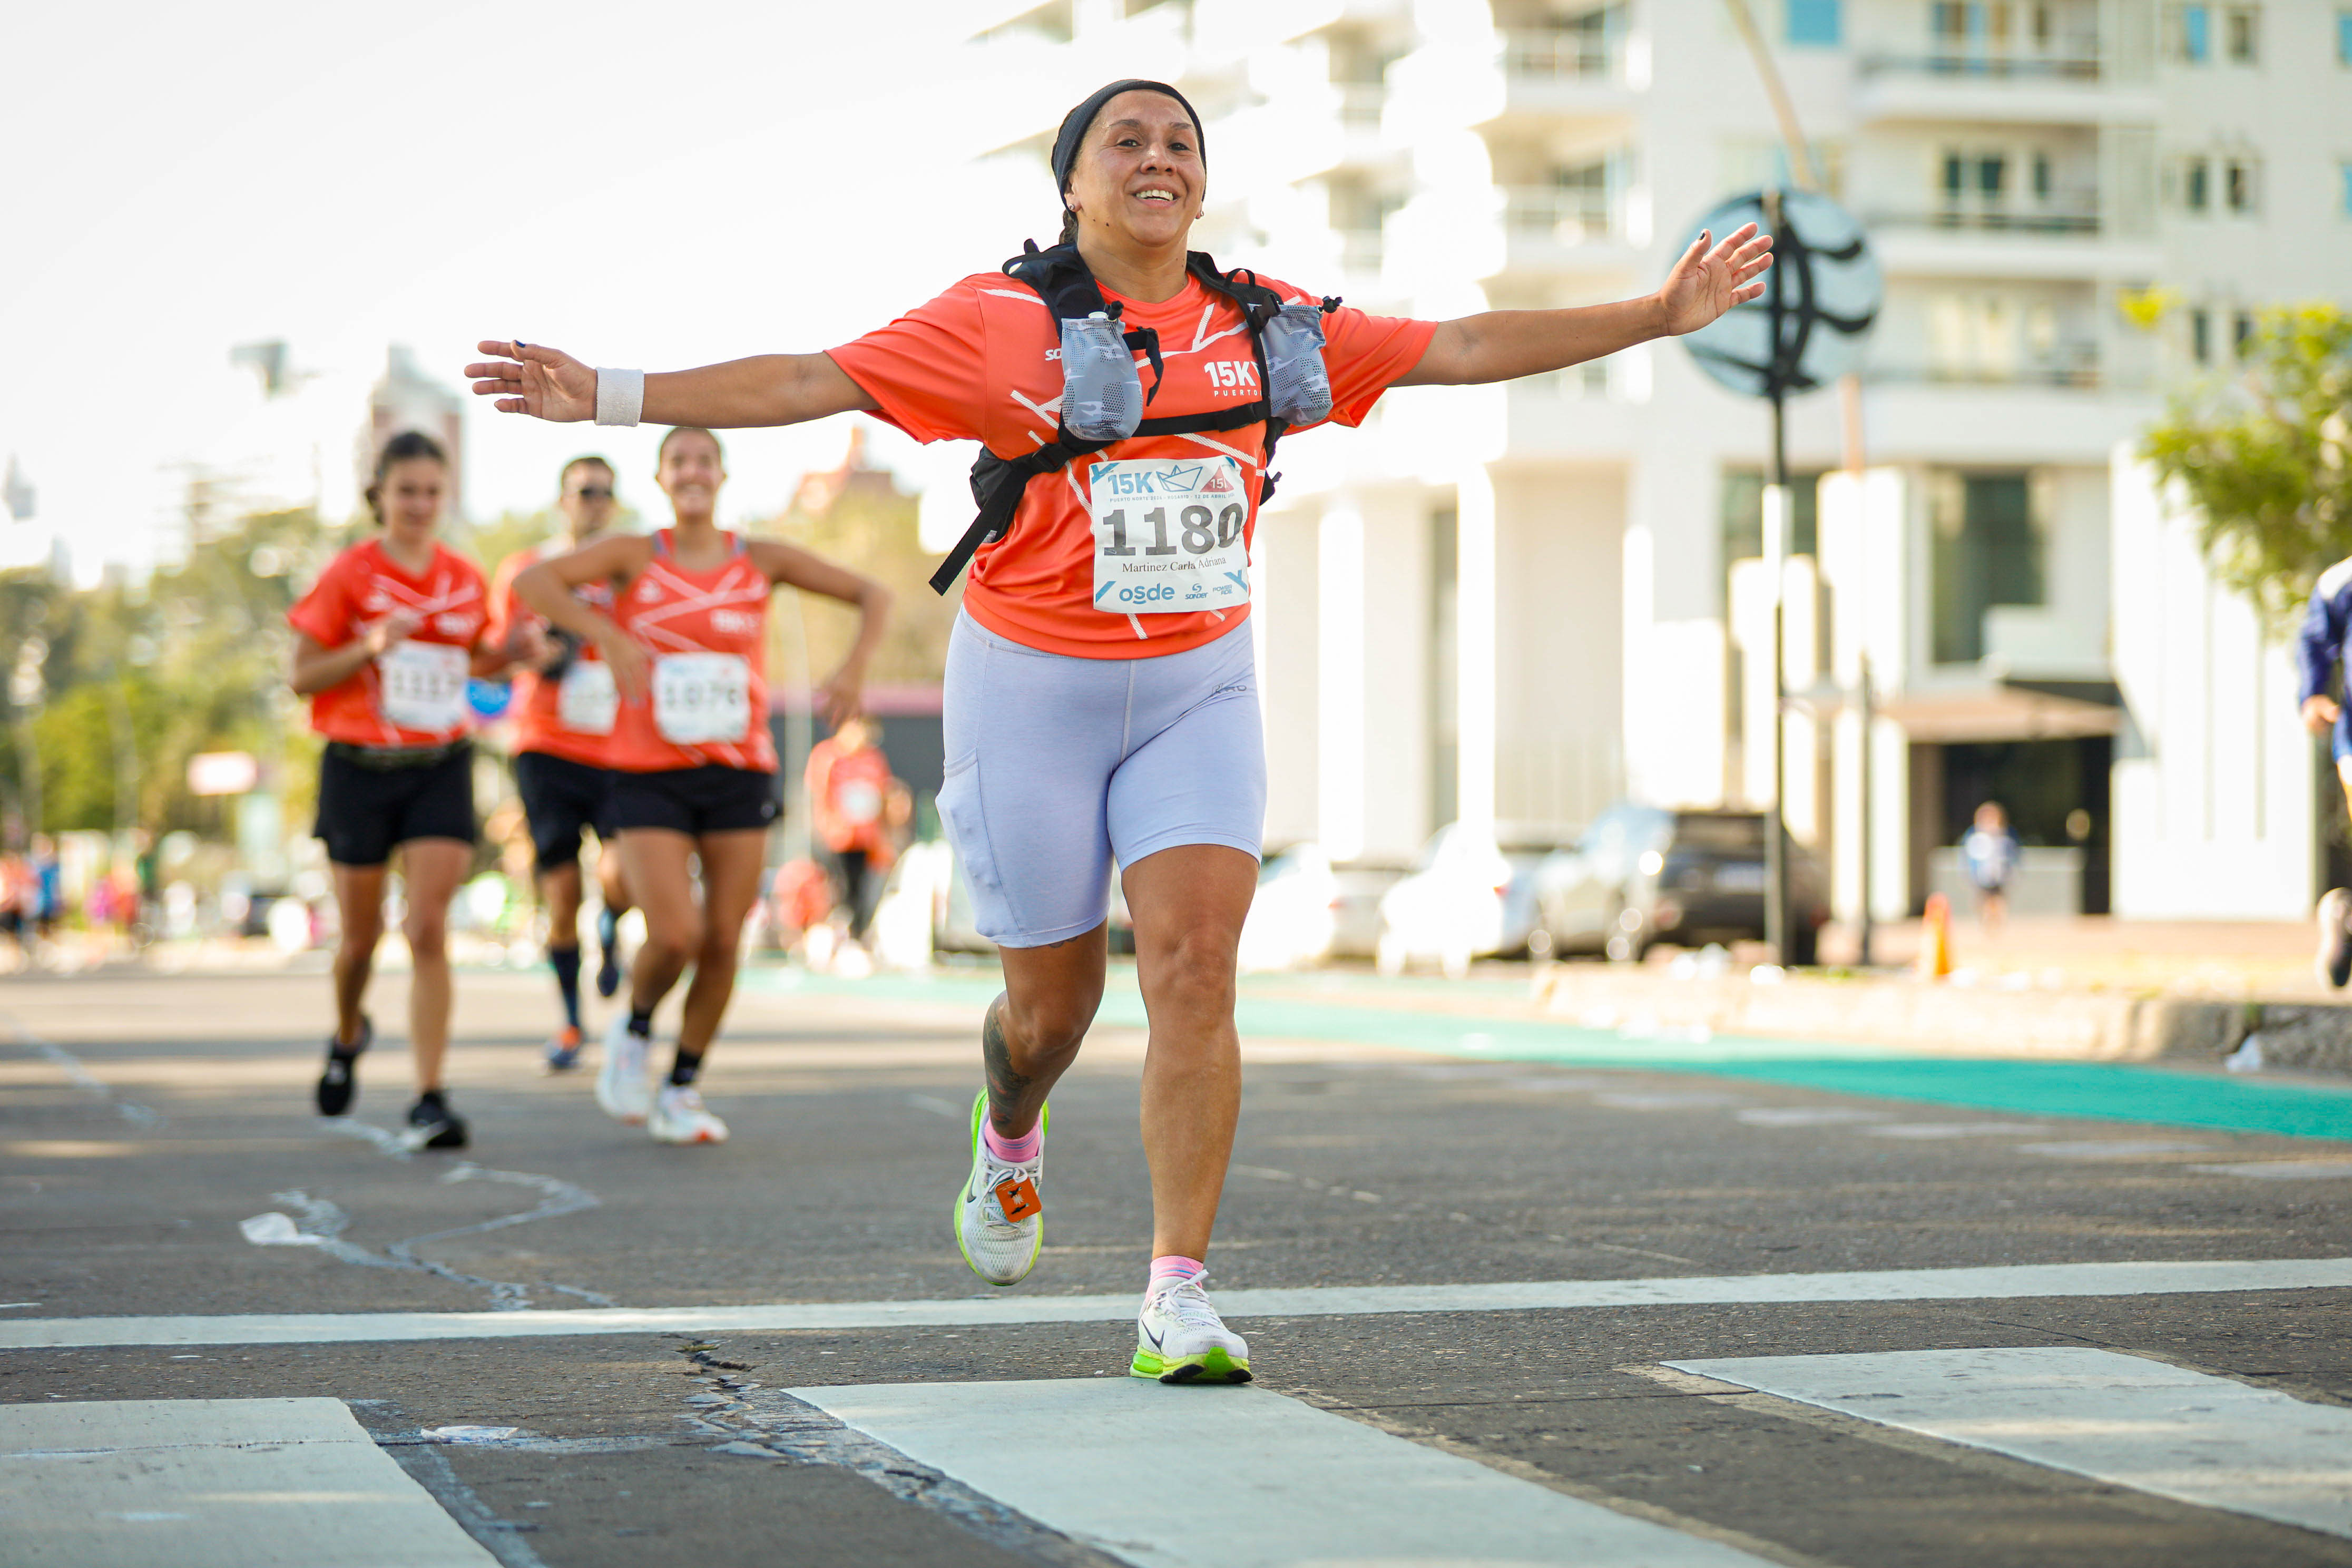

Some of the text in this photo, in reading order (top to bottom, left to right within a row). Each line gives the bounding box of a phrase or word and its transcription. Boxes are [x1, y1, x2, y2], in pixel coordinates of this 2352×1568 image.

[1204, 361, 1257, 387] 15K
[1108, 472, 1154, 494] 15K
[1103, 503, 1243, 556] 1180
[1123, 556, 1227, 572] Martinez Carla Adriana
[1119, 583, 1175, 604] osde
